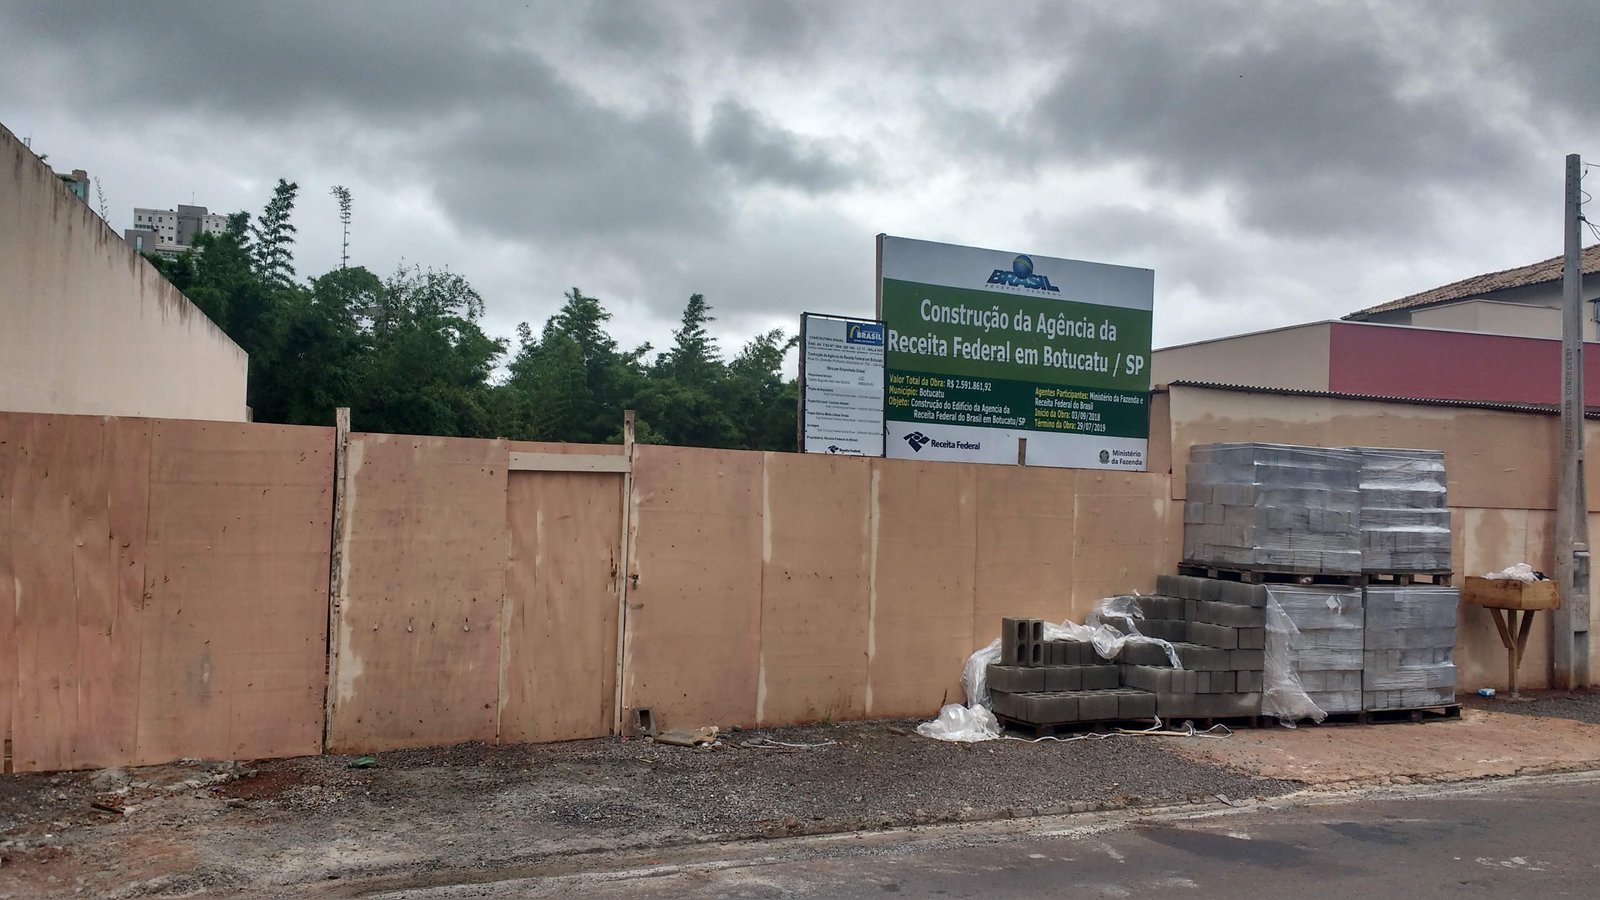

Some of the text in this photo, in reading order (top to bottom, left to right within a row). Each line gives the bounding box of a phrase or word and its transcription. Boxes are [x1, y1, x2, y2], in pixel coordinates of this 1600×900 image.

[986, 269, 1060, 292] BRASIL
[920, 298, 1117, 341] Construção da Agência da
[856, 332, 882, 341] BRASIL
[888, 329, 1145, 377] Receita Federal em Botucatu / SP
[890, 374, 992, 392] Valor Total da Obra: R$ 2.591.861,92
[889, 385, 919, 397] Município:
[919, 388, 945, 398] Botucatu
[1035, 387, 1144, 405] Agentes Participantes: Ministério da Fazenda e
[888, 396, 910, 408] Objeto:
[910, 398, 943, 410] Construção
[943, 400, 951, 410] do
[973, 402, 981, 412] da
[1003, 405, 1010, 414] da
[1034, 397, 1094, 411] Receita Federal do Brasil
[913, 409, 935, 420] Receita
[935, 411, 957, 421] Federal
[958, 412, 966, 422] do
[966, 413, 982, 423] Brasil
[982, 416, 992, 424] em
[1050, 409, 1057, 418] da
[1057, 410, 1071, 419] Obra:
[1071, 410, 1101, 421] 03/09/2018
[1034, 418, 1106, 432] Término da Obra: 29/07/2019
[931, 439, 981, 450] Receita Federal
[1112, 449, 1142, 458] Ministério
[1119, 458, 1143, 466] Fazenda
